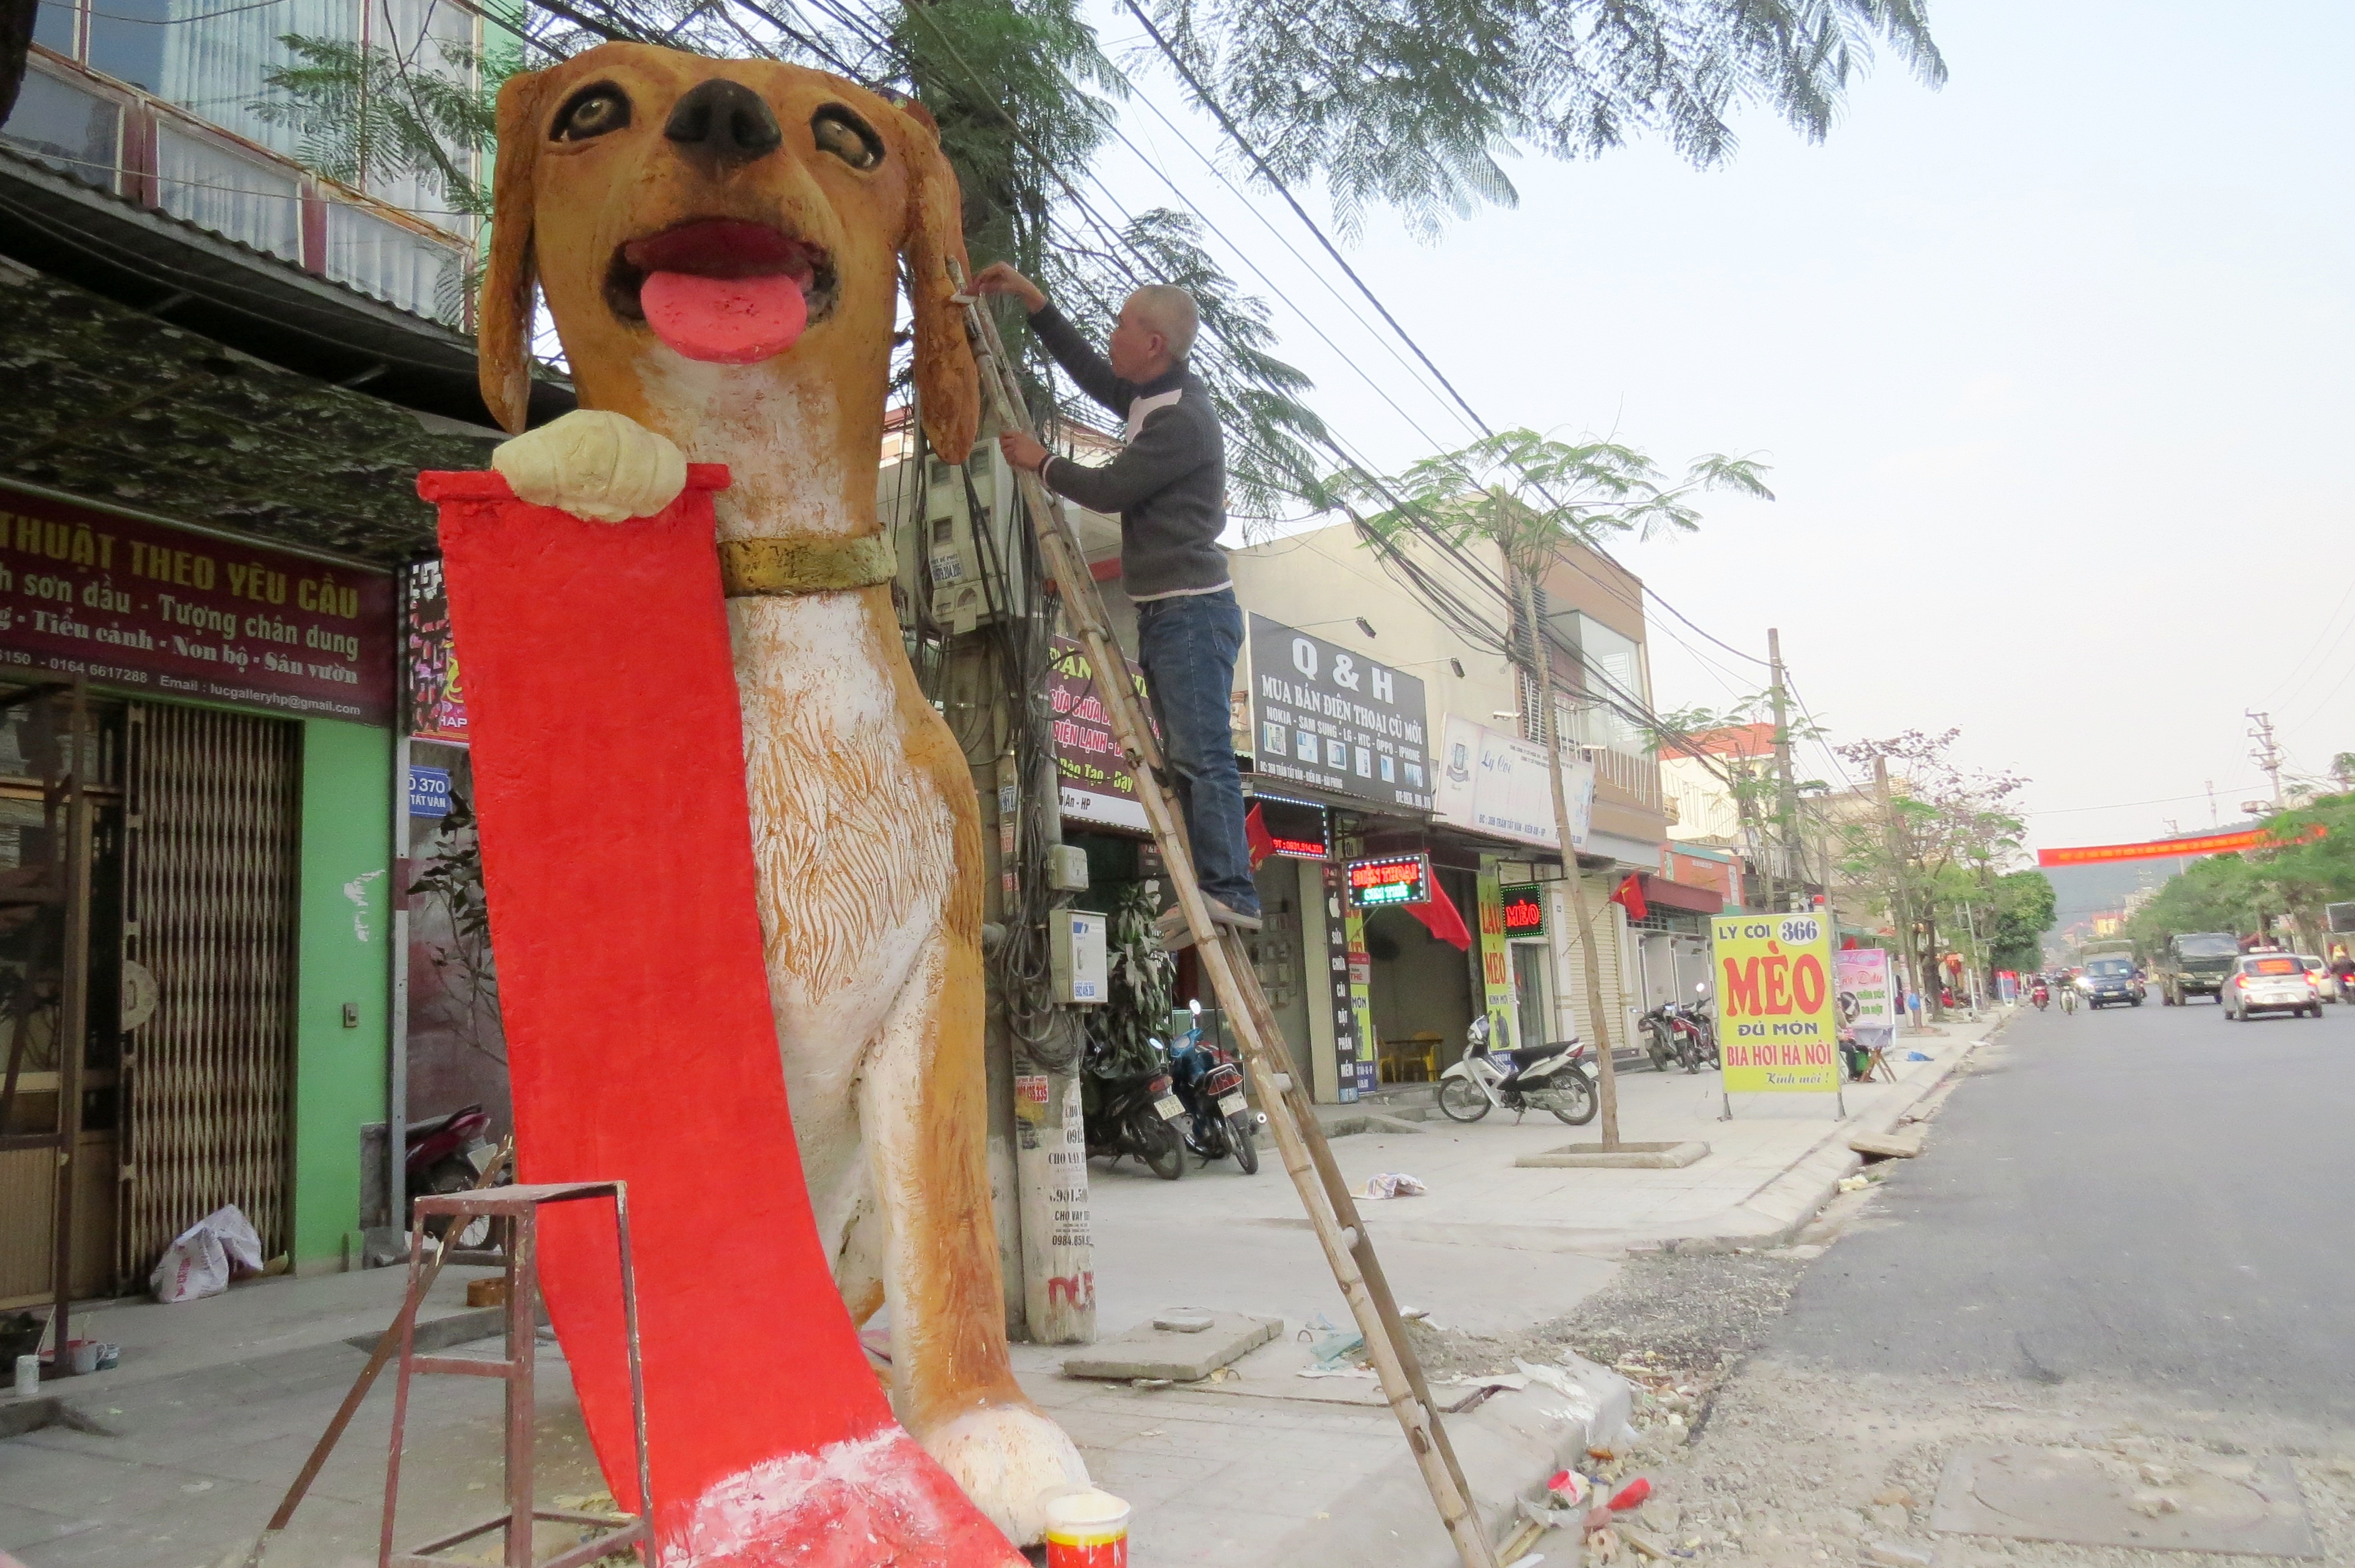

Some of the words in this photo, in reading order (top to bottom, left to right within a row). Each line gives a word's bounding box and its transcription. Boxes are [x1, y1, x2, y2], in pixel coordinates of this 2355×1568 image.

[129, 540, 215, 590] THEO
[227, 562, 287, 604] YÊU
[298, 572, 358, 619] CẦU
[24, 573, 72, 603] sơn
[82, 573, 130, 614] dầu
[158, 593, 237, 640] Tượng
[244, 614, 298, 645] chân
[305, 624, 359, 662] dung
[32, 606, 89, 639] Tiểu
[95, 621, 154, 651] cảnh
[173, 634, 218, 662] Non
[222, 644, 249, 673] bộ
[264, 651, 304, 676] Sân
[307, 661, 359, 685] vườn
[1292, 637, 1319, 682] Q
[1332, 654, 1360, 692] &
[1371, 666, 1394, 705] H
[50, 657, 85, 674] 0164
[160, 675, 198, 692] Email
[210, 683, 361, 716] lucgalleryhp@gmail.com
[1261, 674, 1292, 705] MUA
[1294, 682, 1321, 713] BÁN
[1323, 692, 1351, 726] ĐIỆN
[1353, 704, 1387, 737] THOẠI
[1388, 713, 1402, 739] CŨ
[1266, 705, 1292, 726] NOKIA
[1298, 715, 1316, 733] SAM
[1317, 720, 1338, 739] SUNG
[1343, 727, 1353, 743] LG
[1358, 732, 1371, 749] HTC
[1398, 745, 1421, 763] IPHONE
[419, 778, 446, 793] 370
[1080, 797, 1092, 810] HP
[1505, 899, 1540, 927] MÈO
[1719, 923, 1738, 940] LÝ
[1744, 922, 1770, 939] CÒI
[1782, 920, 1818, 942] 366
[1723, 939, 1826, 1017] MÈO
[1737, 1020, 1765, 1037] ĐỦ
[1773, 1019, 1818, 1036] MÓN
[1726, 1045, 1749, 1067] BIA
[1752, 1044, 1778, 1065] HƠI
[1782, 1039, 1802, 1065] HÀ
[1806, 1039, 1832, 1069] NỘI
[1765, 1072, 1795, 1085] Kính
[1049, 1152, 1066, 1165] CHO
[1054, 1210, 1070, 1221] CHO
[1072, 1210, 1083, 1221] VAY
